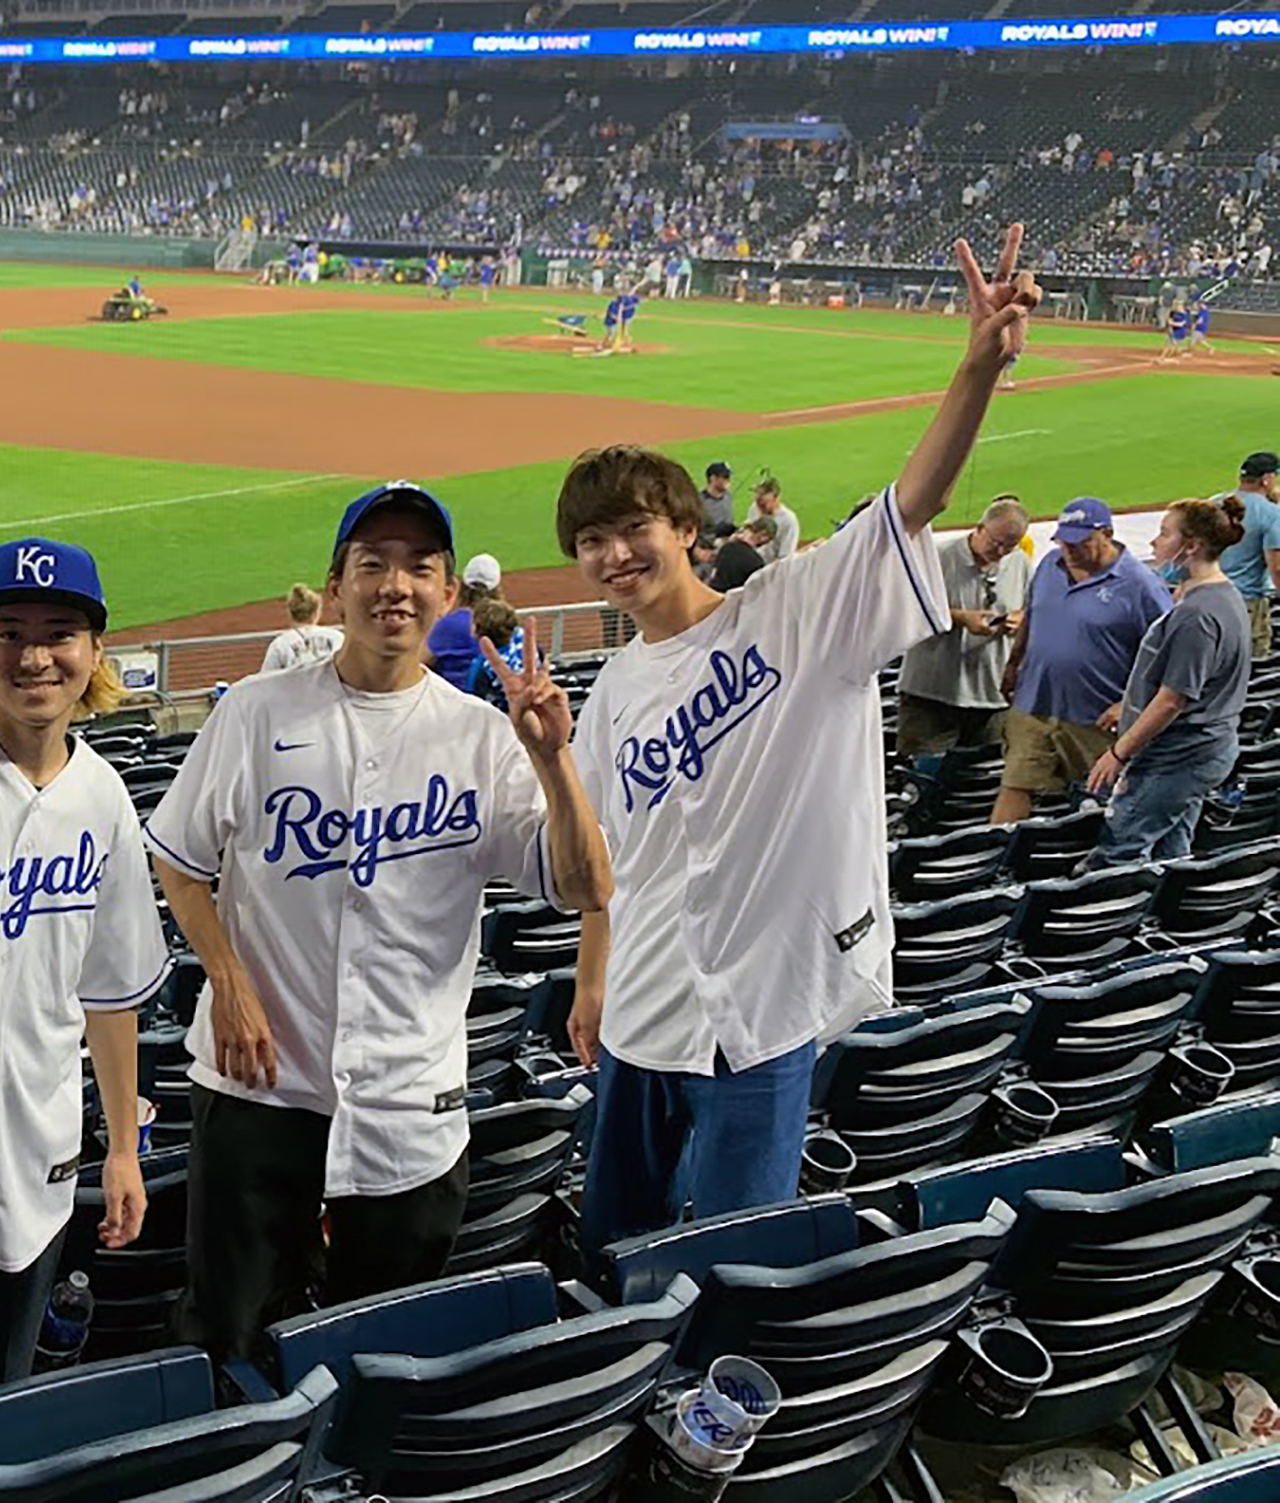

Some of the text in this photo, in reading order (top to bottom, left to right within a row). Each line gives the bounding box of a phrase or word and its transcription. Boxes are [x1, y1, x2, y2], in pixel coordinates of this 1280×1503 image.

[808, 27, 886, 46] ROYALS
[1000, 22, 1143, 41] ROYALS WIN!
[15, 546, 54, 587] KC
[615, 643, 781, 813] Royals
[264, 774, 481, 887] Royals
